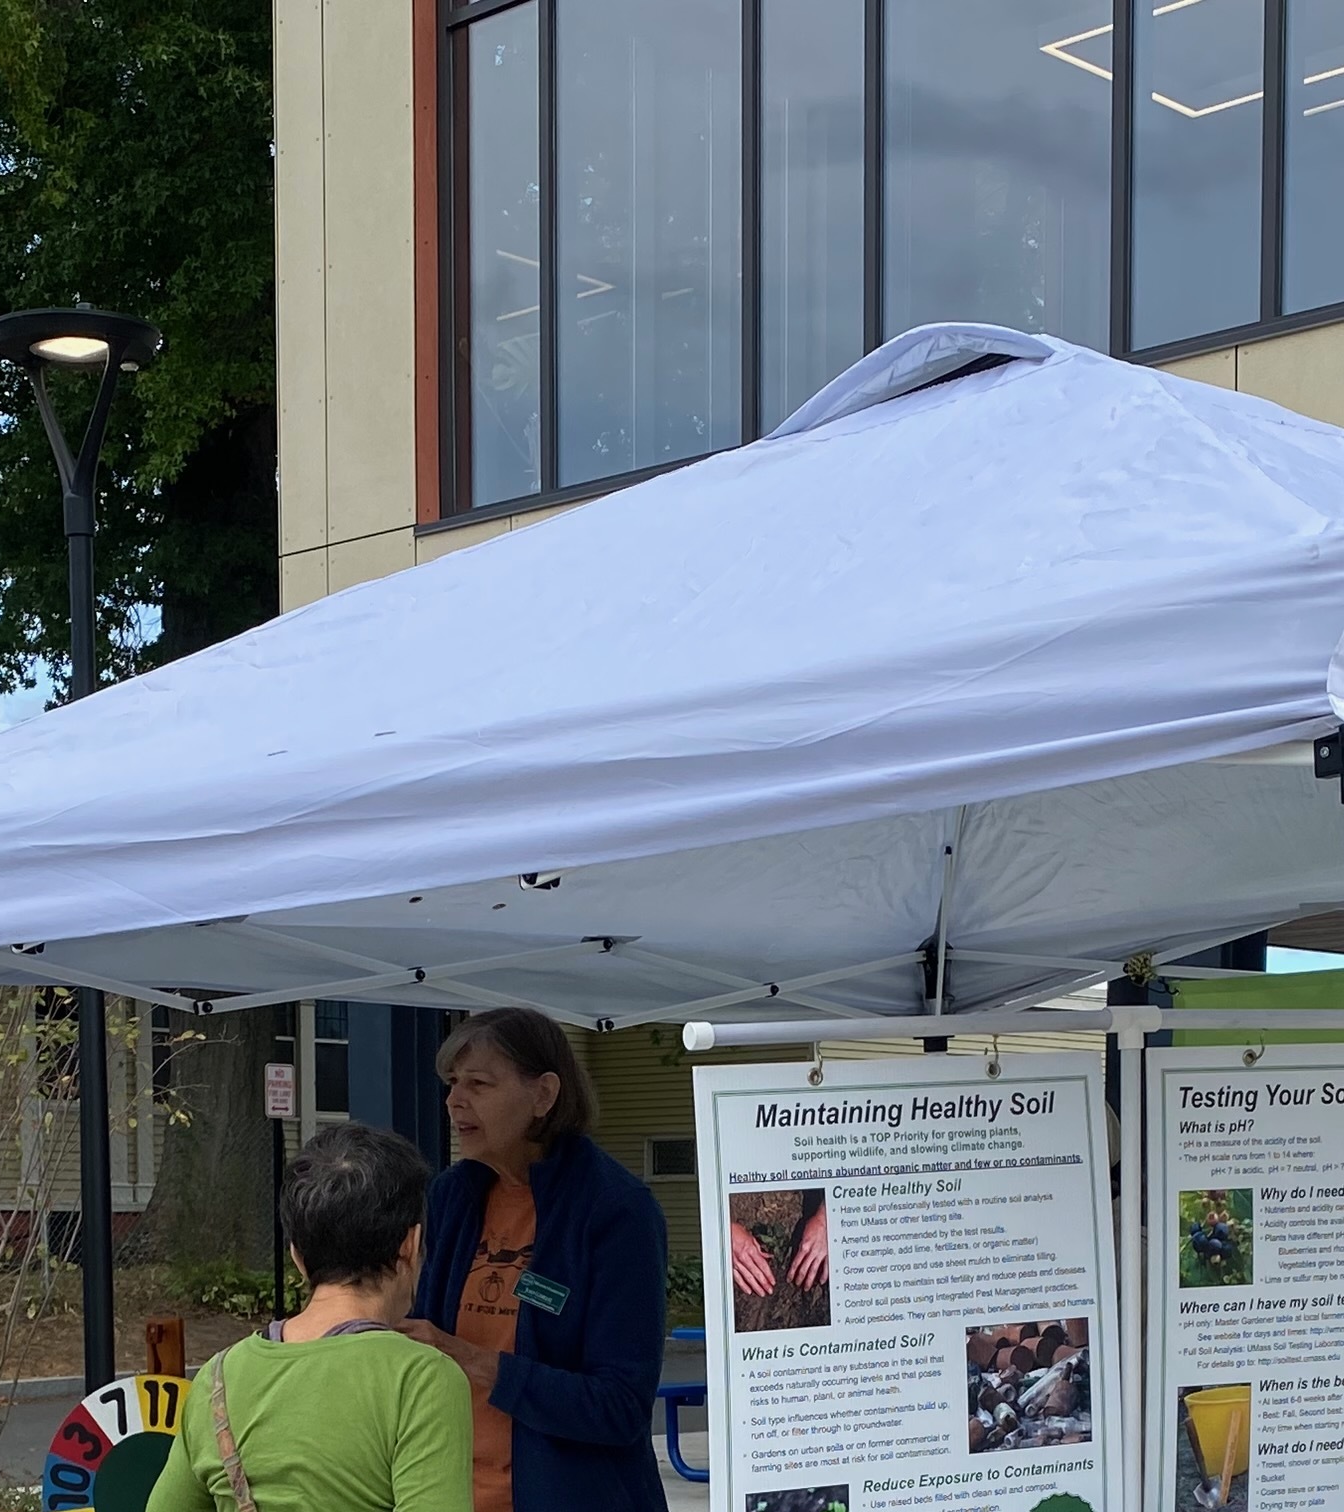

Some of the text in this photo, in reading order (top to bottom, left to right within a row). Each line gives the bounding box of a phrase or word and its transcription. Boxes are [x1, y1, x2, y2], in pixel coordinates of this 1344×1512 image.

[755, 1090, 1055, 1128] Maintaining Healthy Soil
[1179, 1085, 1259, 1113] Testing
[1265, 1083, 1316, 1106] Your
[794, 1125, 1022, 1147] Soil health is a TOP Priority for growing plants,
[1179, 1118, 1255, 1135] What is pH?
[791, 1140, 1025, 1163] supporting wildlife, and slowing climate change.
[729, 1154, 1084, 1184] Healthy soil contains abundant organic matter and few or no contaminants.
[832, 1177, 962, 1199] Create Healthy Soil
[1260, 1187, 1288, 1203] Why
[1290, 1186, 1306, 1199] do
[1309, 1185, 1314, 1199] I
[843, 1251, 1058, 1276] Grow cover crops and use sheet mulch to eliminate tilling.
[1180, 1301, 1220, 1315] Where
[1223, 1301, 1246, 1312] can
[1249, 1298, 1254, 1311] I
[1256, 1297, 1287, 1310] have
[1289, 1298, 1309, 1311] my
[1311, 1293, 1335, 1307] soil
[742, 1332, 935, 1362] What is Contaminated Soil?
[1259, 1379, 1294, 1393] When
[1297, 1377, 1309, 1390] is
[1311, 1376, 1331, 1389] the
[99, 1387, 127, 1436] 7
[143, 1379, 179, 1428] 11
[63, 1422, 103, 1461] 3
[1257, 1442, 1289, 1456] What
[1291, 1440, 1307, 1454] do
[1309, 1439, 1315, 1452] I
[1315, 1437, 1344, 1452] need
[48, 1463, 90, 1511] 10
[862, 1458, 1094, 1494] Reduce Exposure to Contaminants
[1260, 1473, 1286, 1483] Bucket
